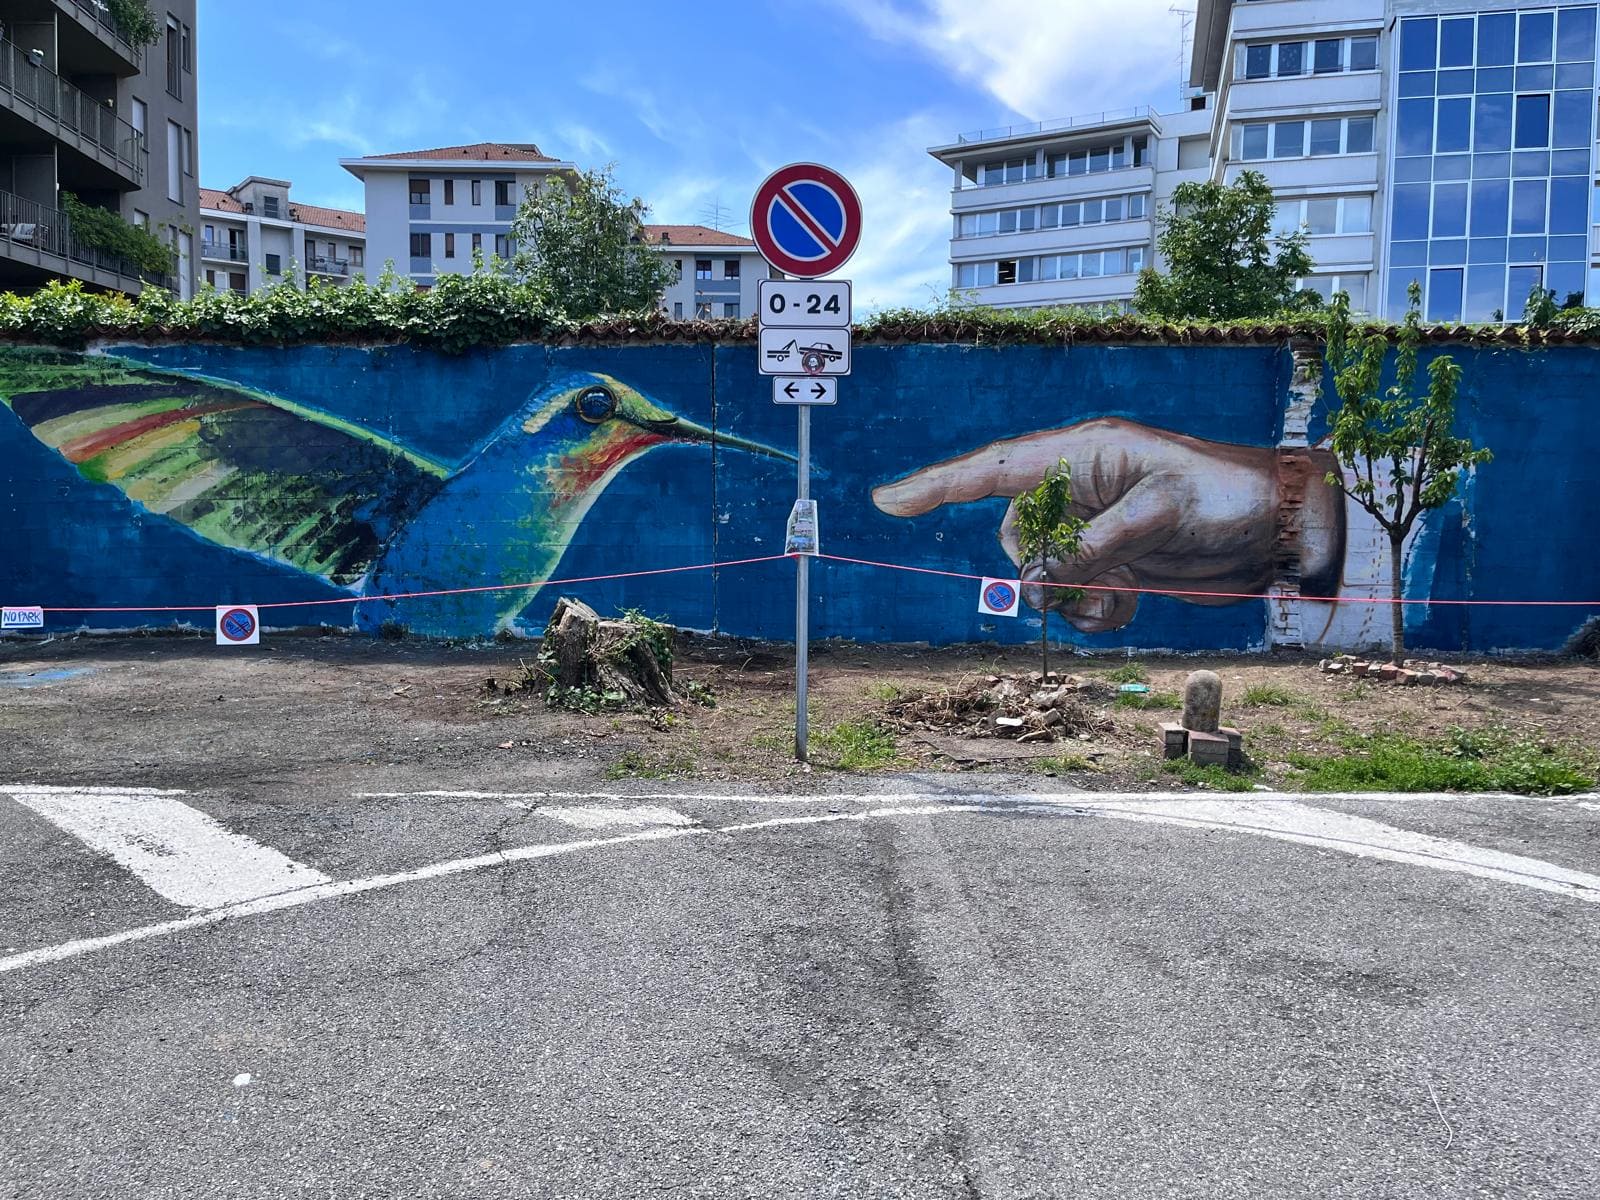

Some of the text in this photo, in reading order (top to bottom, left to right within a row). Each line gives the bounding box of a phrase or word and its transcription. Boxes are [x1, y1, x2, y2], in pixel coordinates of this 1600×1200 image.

[769, 293, 786, 314] 0
[806, 293, 841, 314] 24
[3, 611, 41, 622] NO PARK
